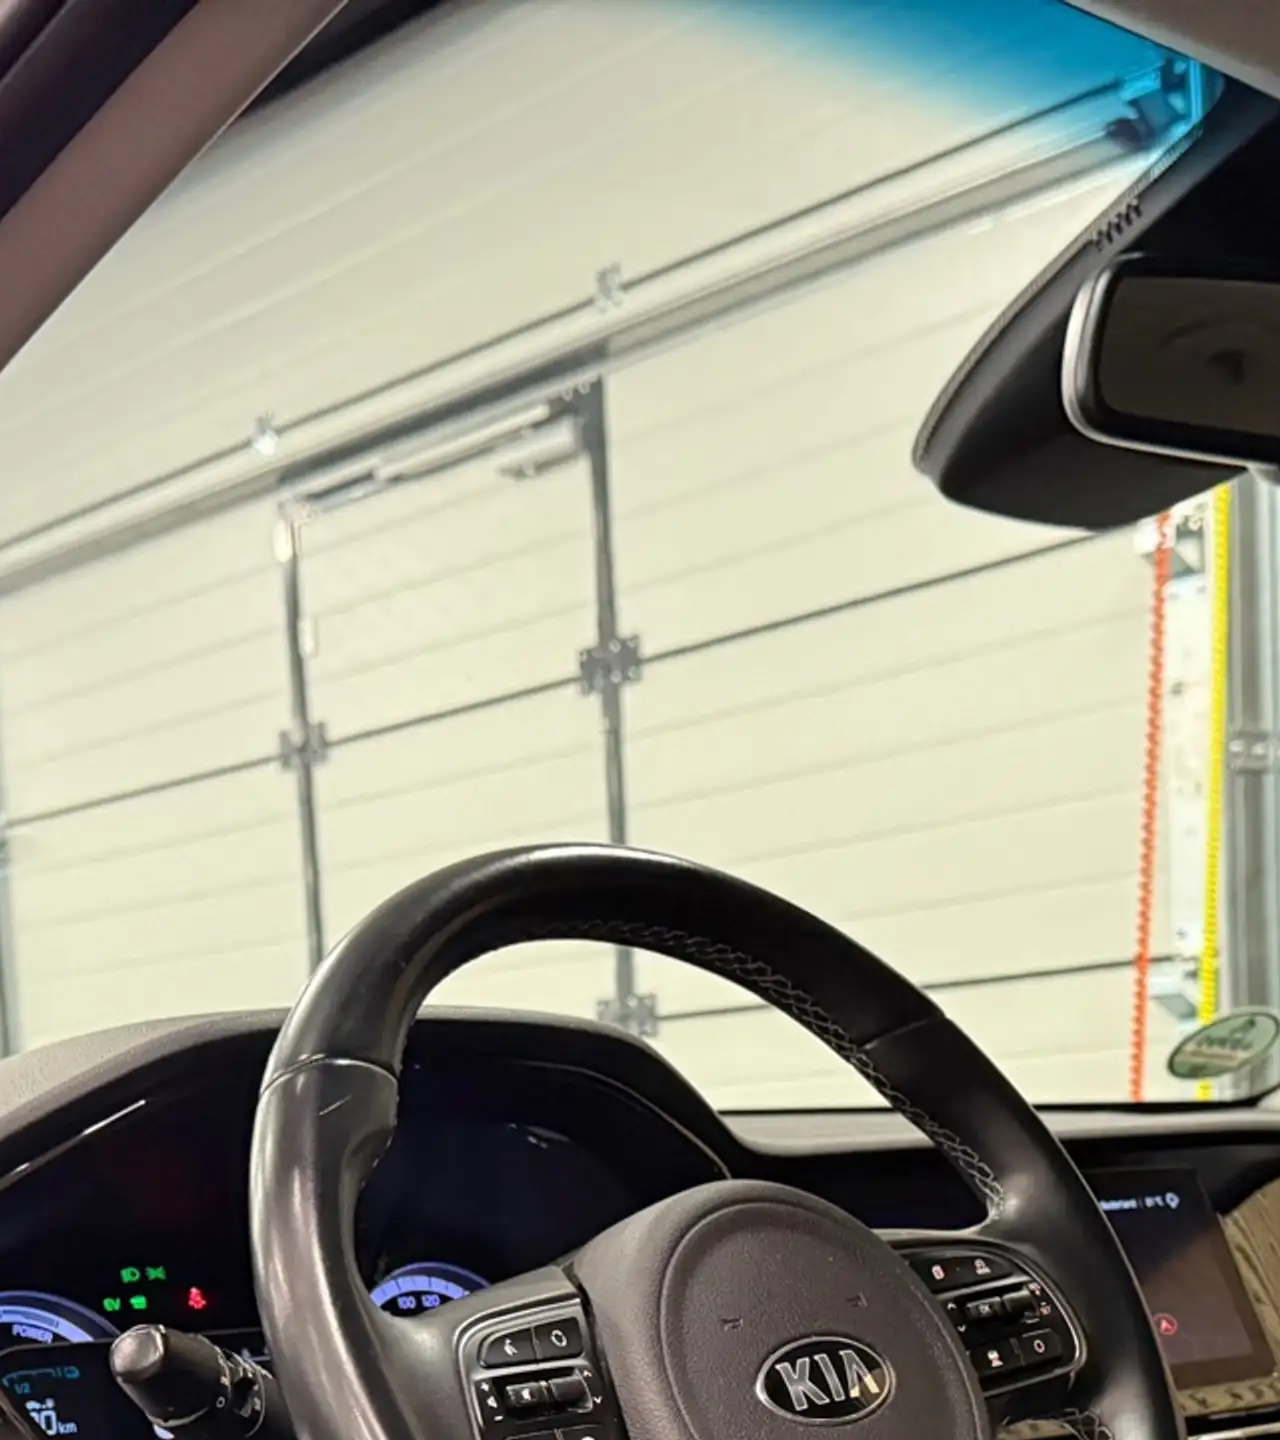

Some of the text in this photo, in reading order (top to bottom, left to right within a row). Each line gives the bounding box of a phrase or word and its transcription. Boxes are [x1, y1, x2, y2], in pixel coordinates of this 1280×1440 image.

[11, 1323, 54, 1344] POWER
[775, 1349, 881, 1412] KIA
[57, 1421, 78, 1435] km
